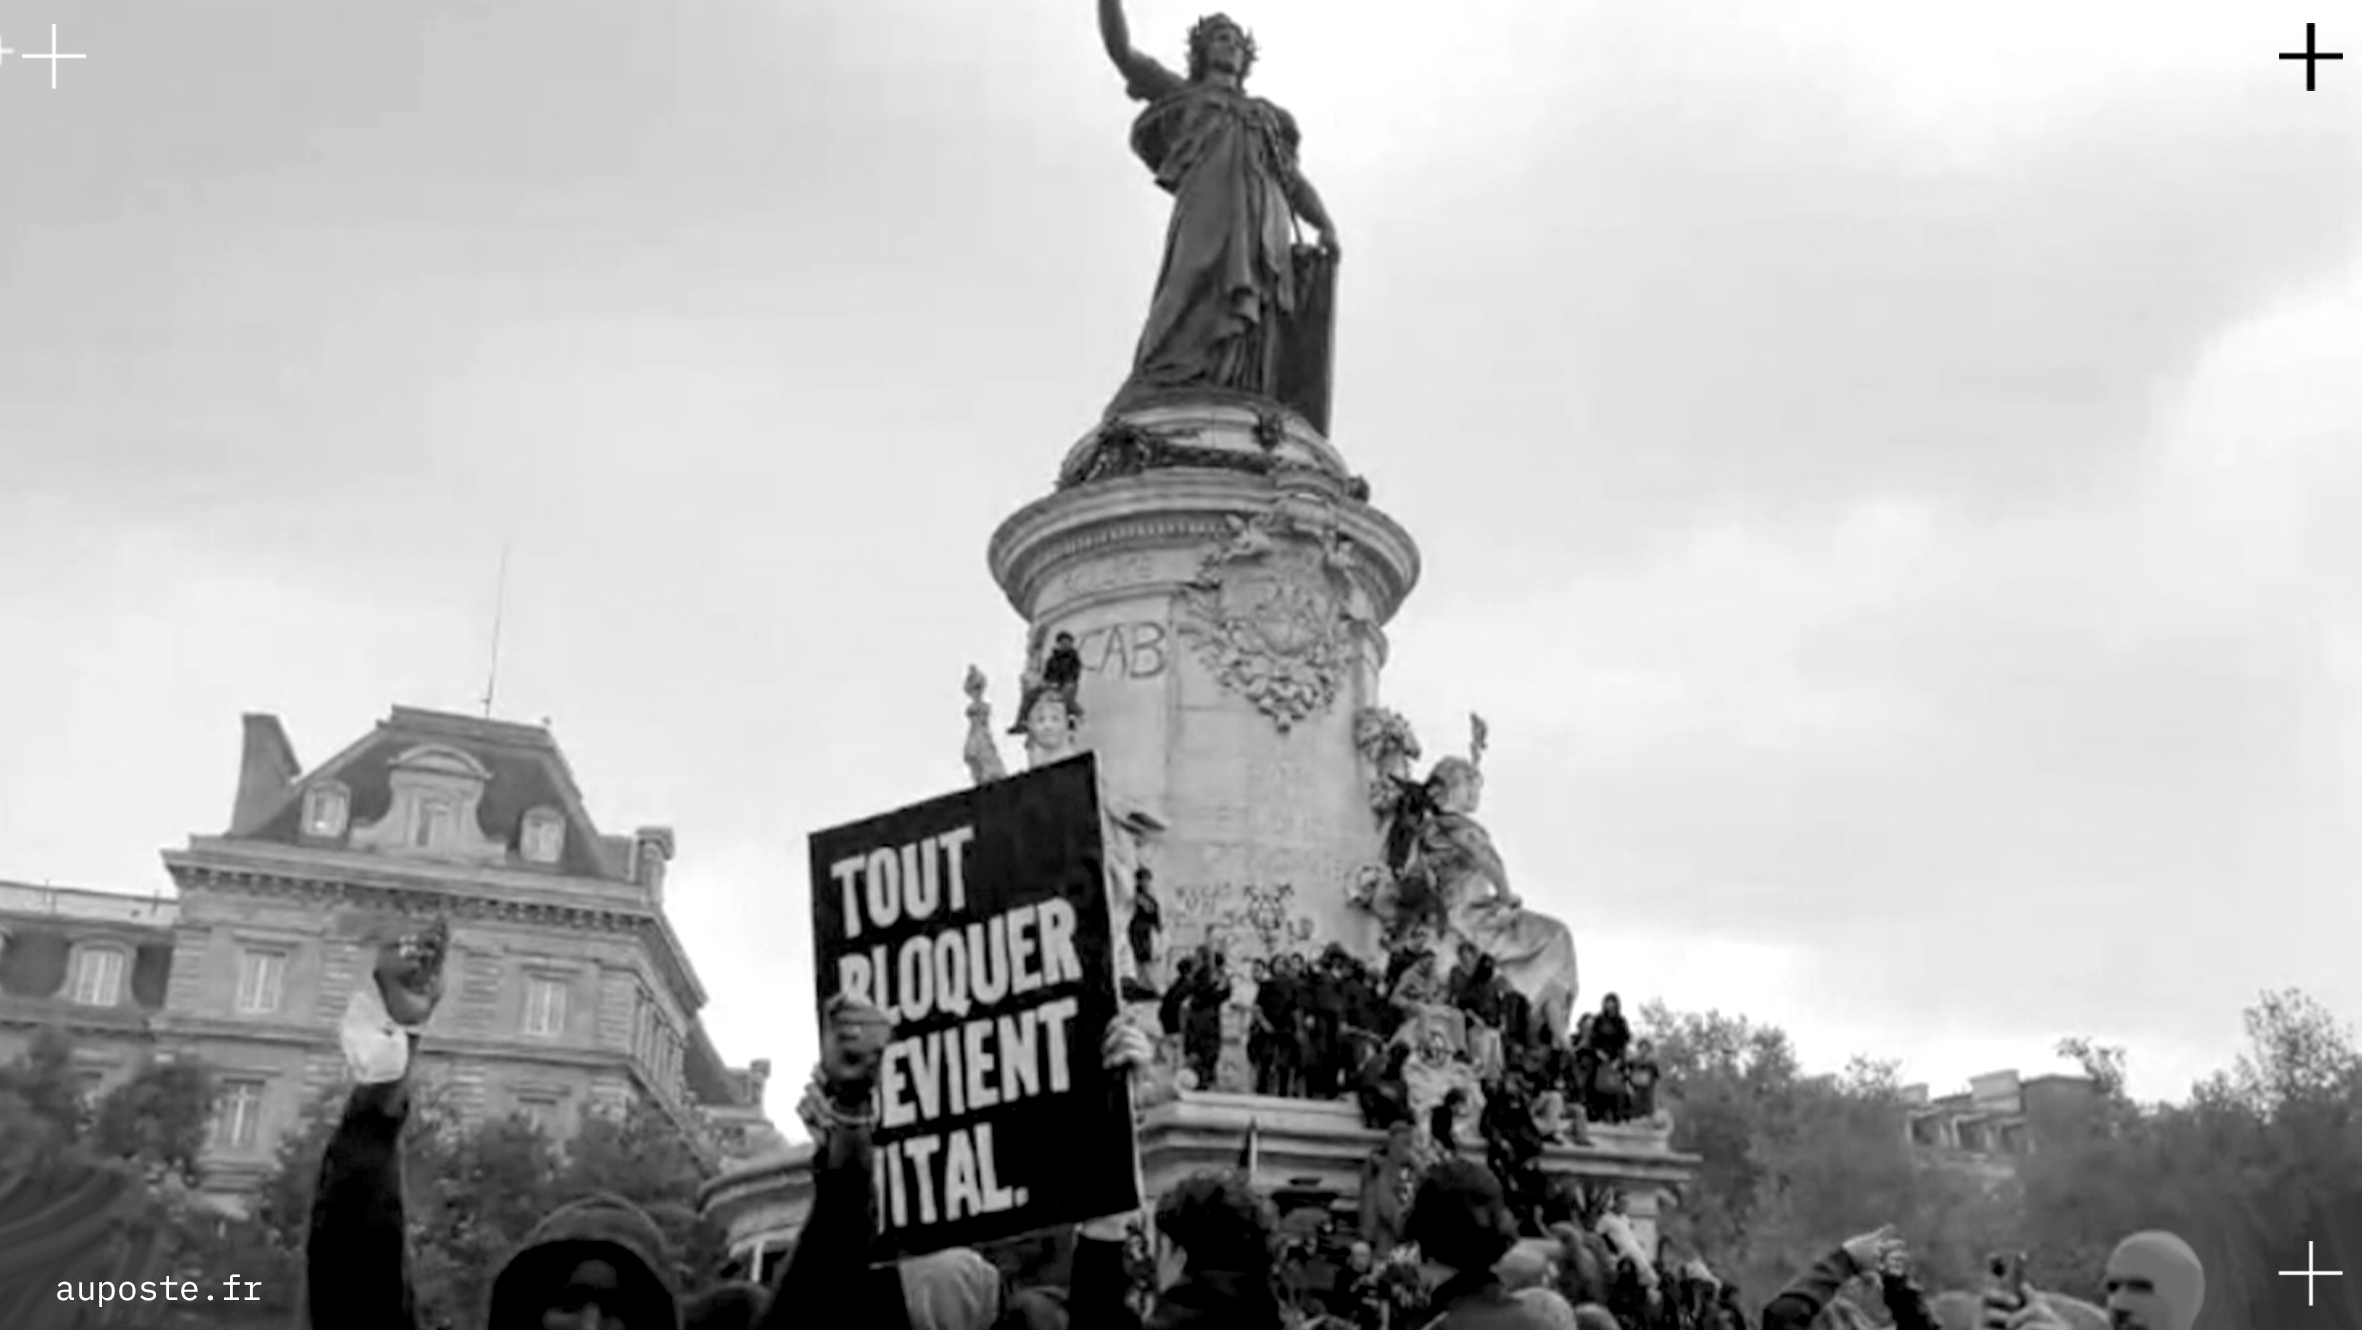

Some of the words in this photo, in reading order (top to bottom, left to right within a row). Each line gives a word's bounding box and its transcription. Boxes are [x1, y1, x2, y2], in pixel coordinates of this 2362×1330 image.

[831, 826, 974, 938] TOUT
[838, 898, 1082, 1026] BLOQUER
[872, 998, 1079, 1128] EVIENT
